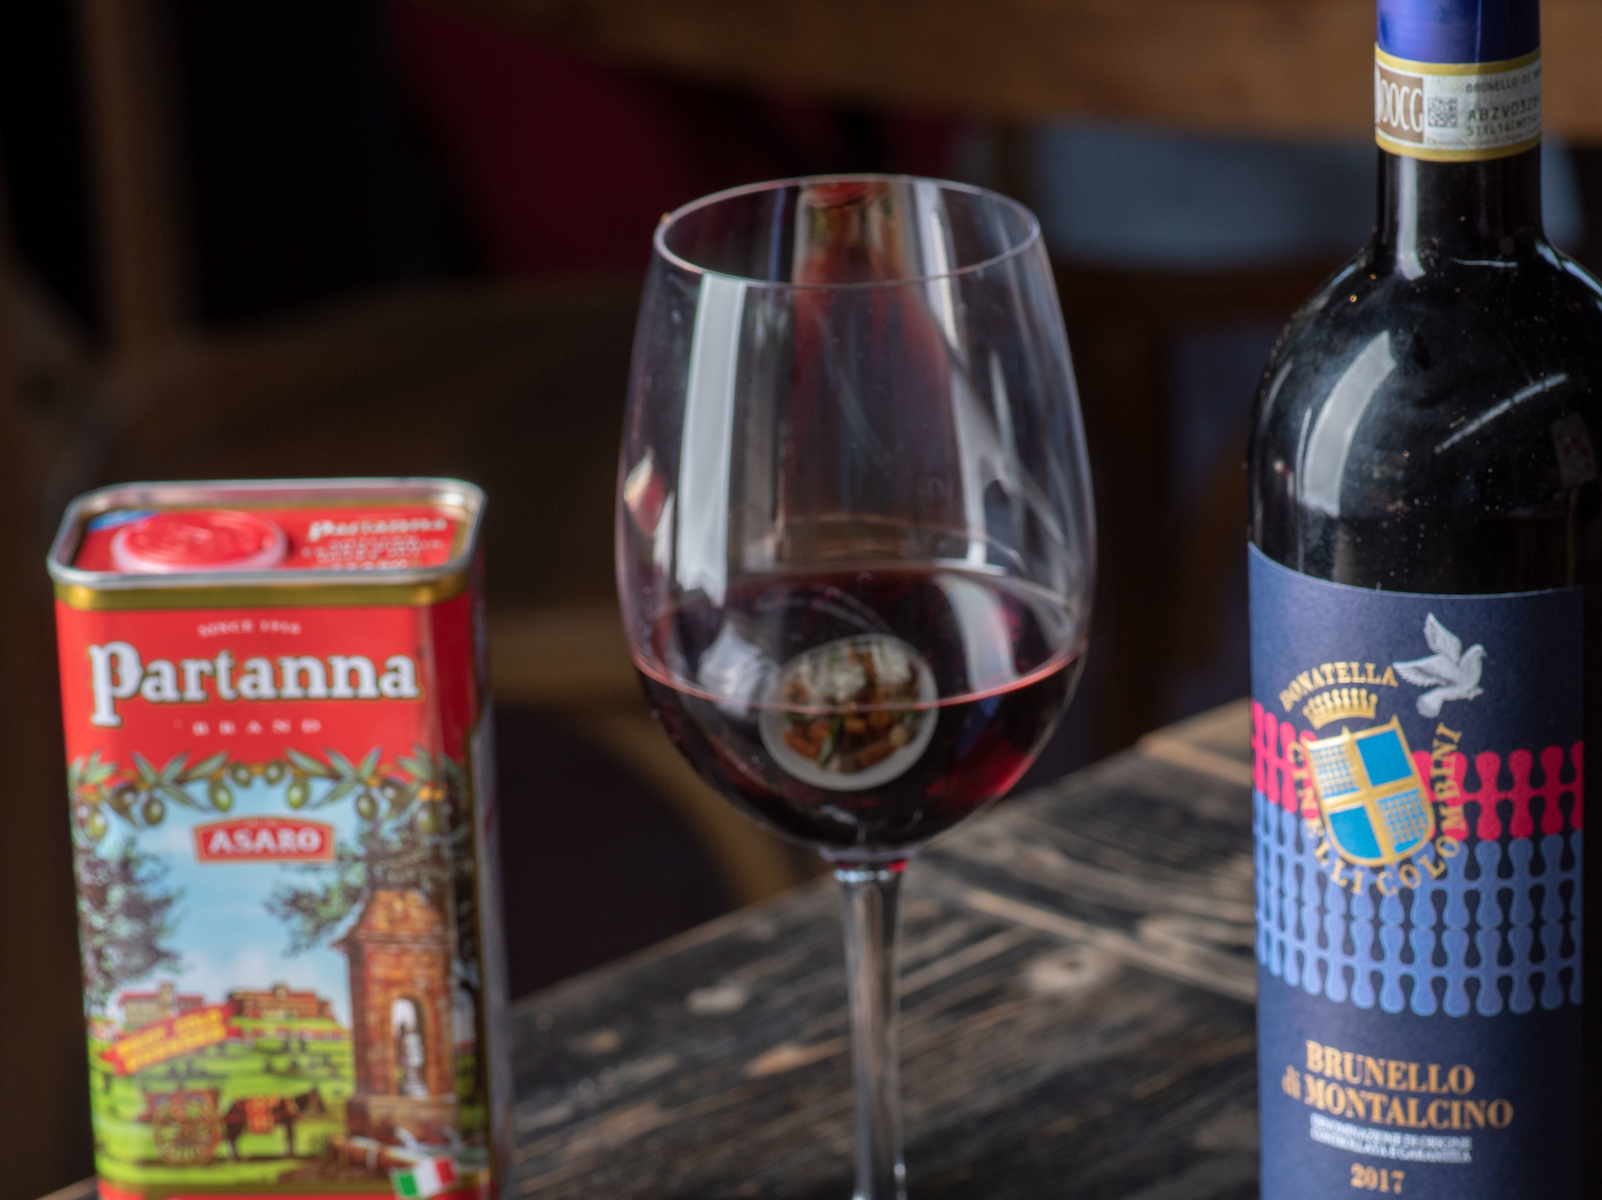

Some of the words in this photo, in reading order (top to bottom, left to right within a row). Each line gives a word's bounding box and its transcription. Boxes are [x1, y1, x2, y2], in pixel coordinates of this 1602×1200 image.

[197, 619, 254, 639] SINCE
[88, 640, 421, 727] Partanna
[1279, 662, 1399, 712] DONATELLA
[192, 718, 322, 737] BRAND
[1287, 741, 1364, 895] CINELLI
[1376, 722, 1466, 896] COLOMBINI
[208, 827, 323, 855] ASARO
[1305, 1039, 1475, 1095] BRUNELLO
[1304, 1074, 1514, 1130] MONTALCINO
[1350, 1163, 1406, 1195] 2017
